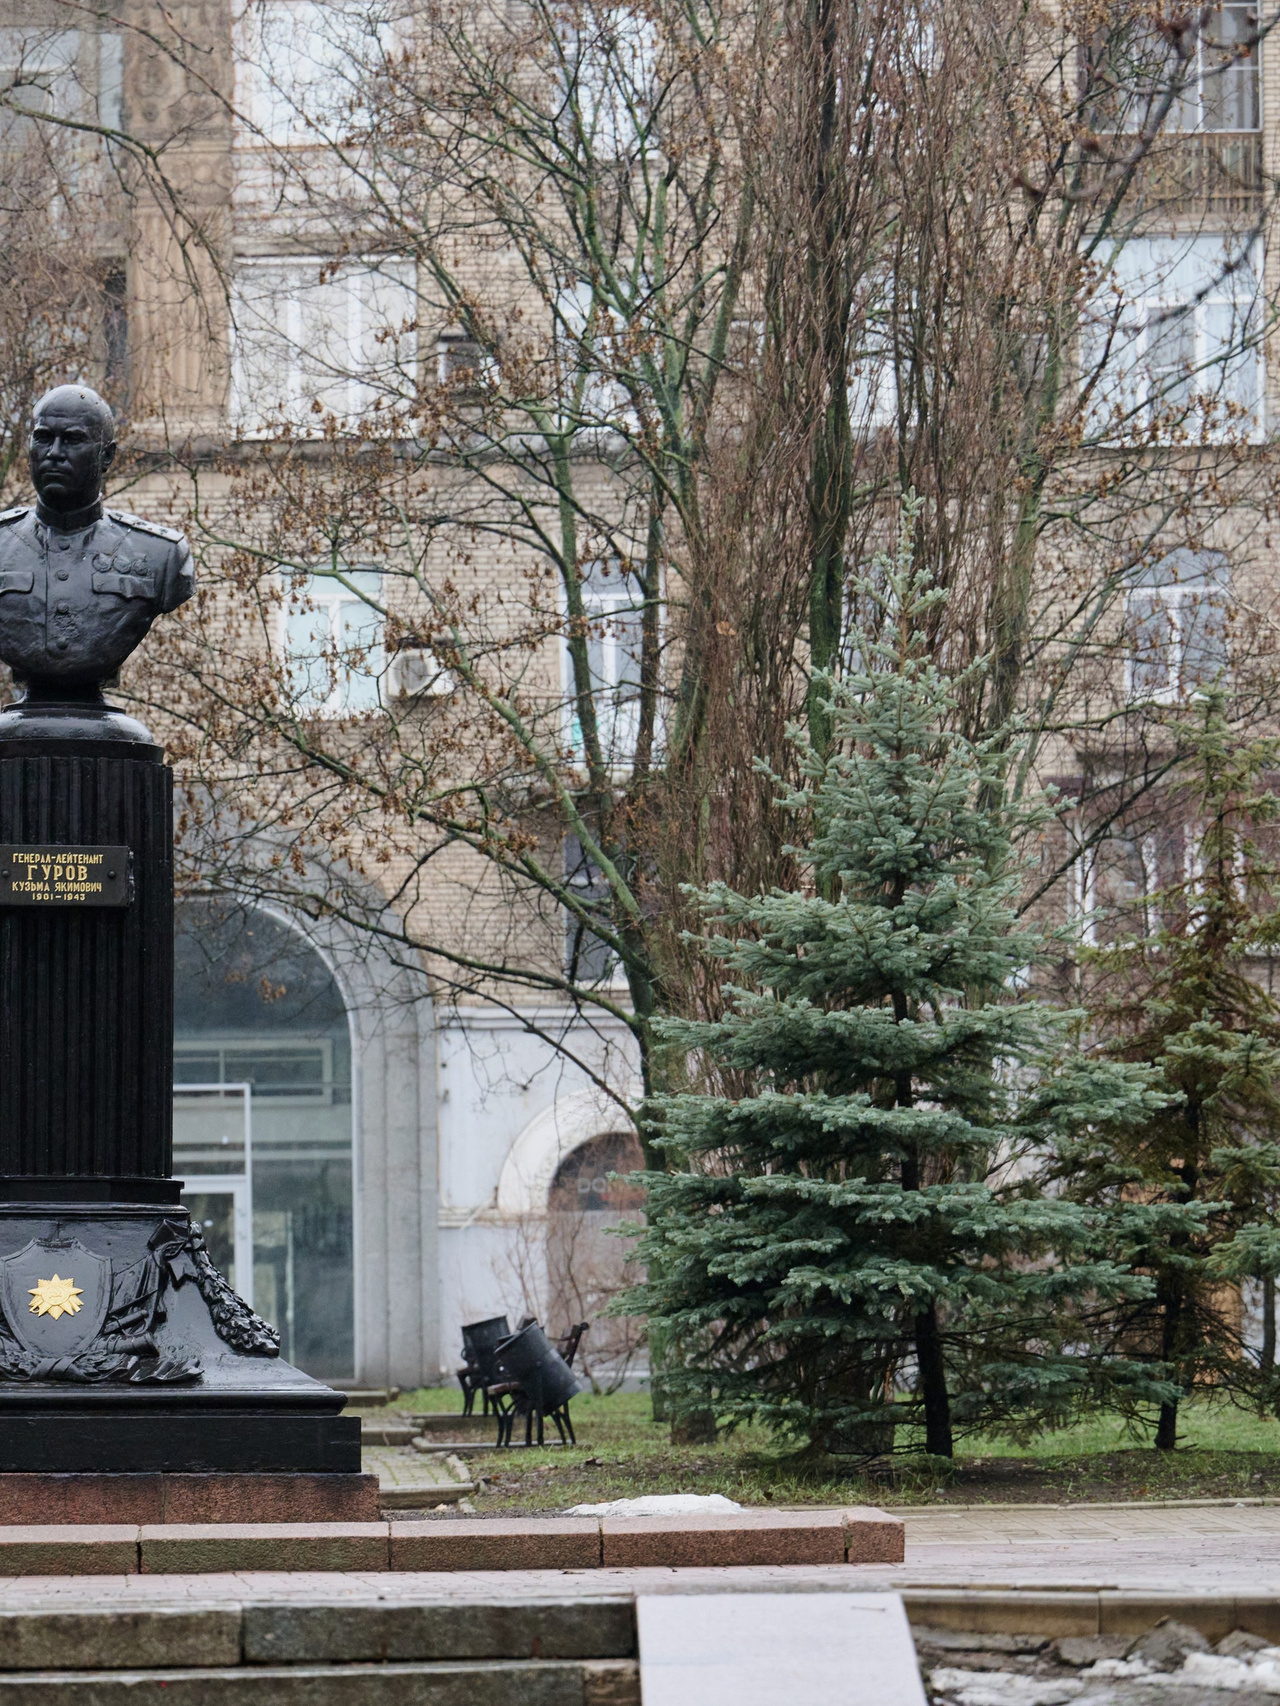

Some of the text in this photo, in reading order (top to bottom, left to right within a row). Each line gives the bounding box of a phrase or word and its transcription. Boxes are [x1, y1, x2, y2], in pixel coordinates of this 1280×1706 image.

[12, 852, 104, 864] ГЕНЕРАЛ-ЛЕЙТЕНАНТ
[27, 864, 88, 880] ГУРОВ
[12, 881, 102, 892] КУЗЬМА ЯКИМОВИЧ
